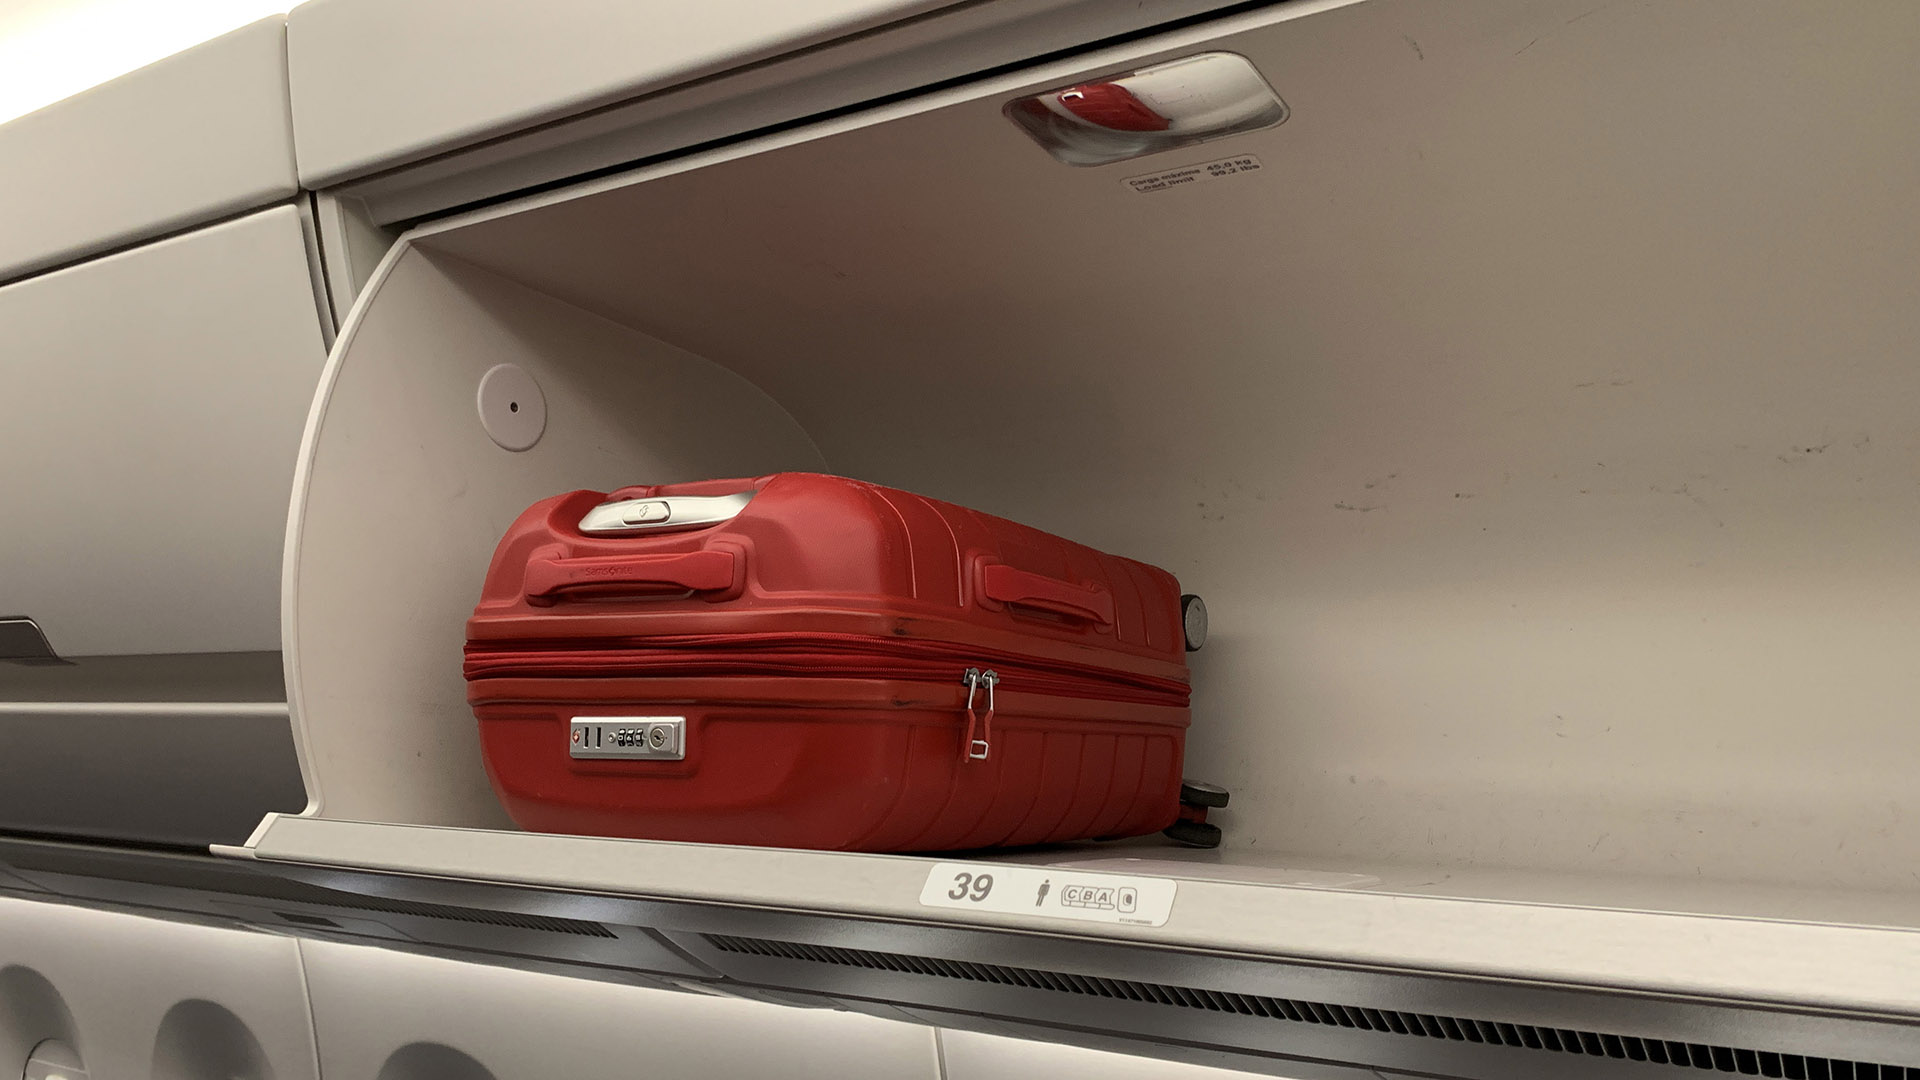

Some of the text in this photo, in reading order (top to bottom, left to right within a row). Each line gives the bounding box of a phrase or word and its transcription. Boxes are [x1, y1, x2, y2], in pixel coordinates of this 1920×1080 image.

[1129, 177, 1159, 186] Carga
[1135, 182, 1166, 192] Load
[1168, 177, 1195, 186] limit
[585, 566, 633, 576] Samsonite
[948, 872, 1107, 903] 39 C B A
